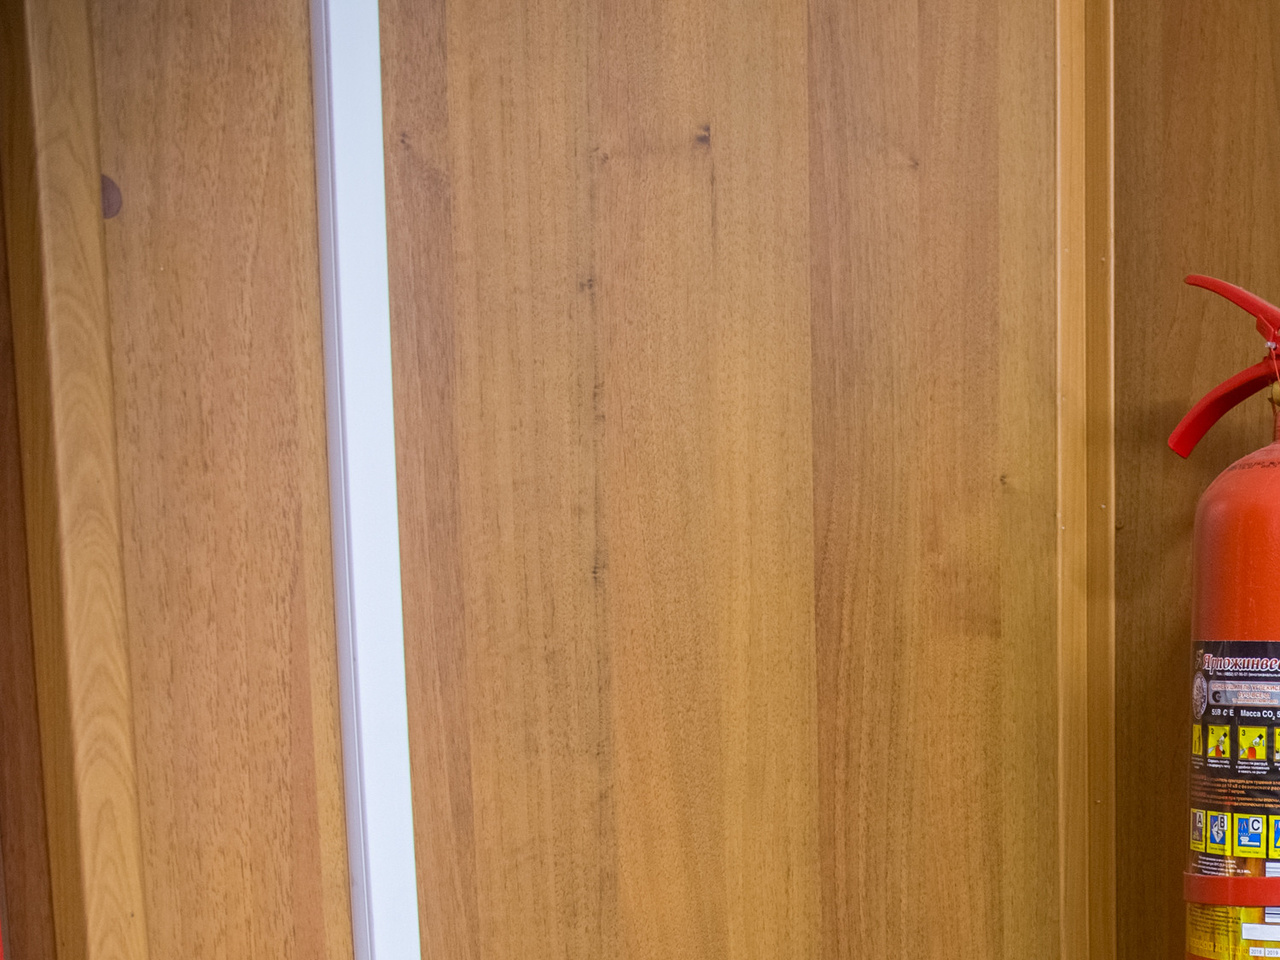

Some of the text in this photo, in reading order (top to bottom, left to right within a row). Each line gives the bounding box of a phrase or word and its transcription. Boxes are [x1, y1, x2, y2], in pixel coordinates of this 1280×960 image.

[1198, 814, 1202, 825] A
[1220, 816, 1225, 828] B
[1251, 819, 1260, 831] C
